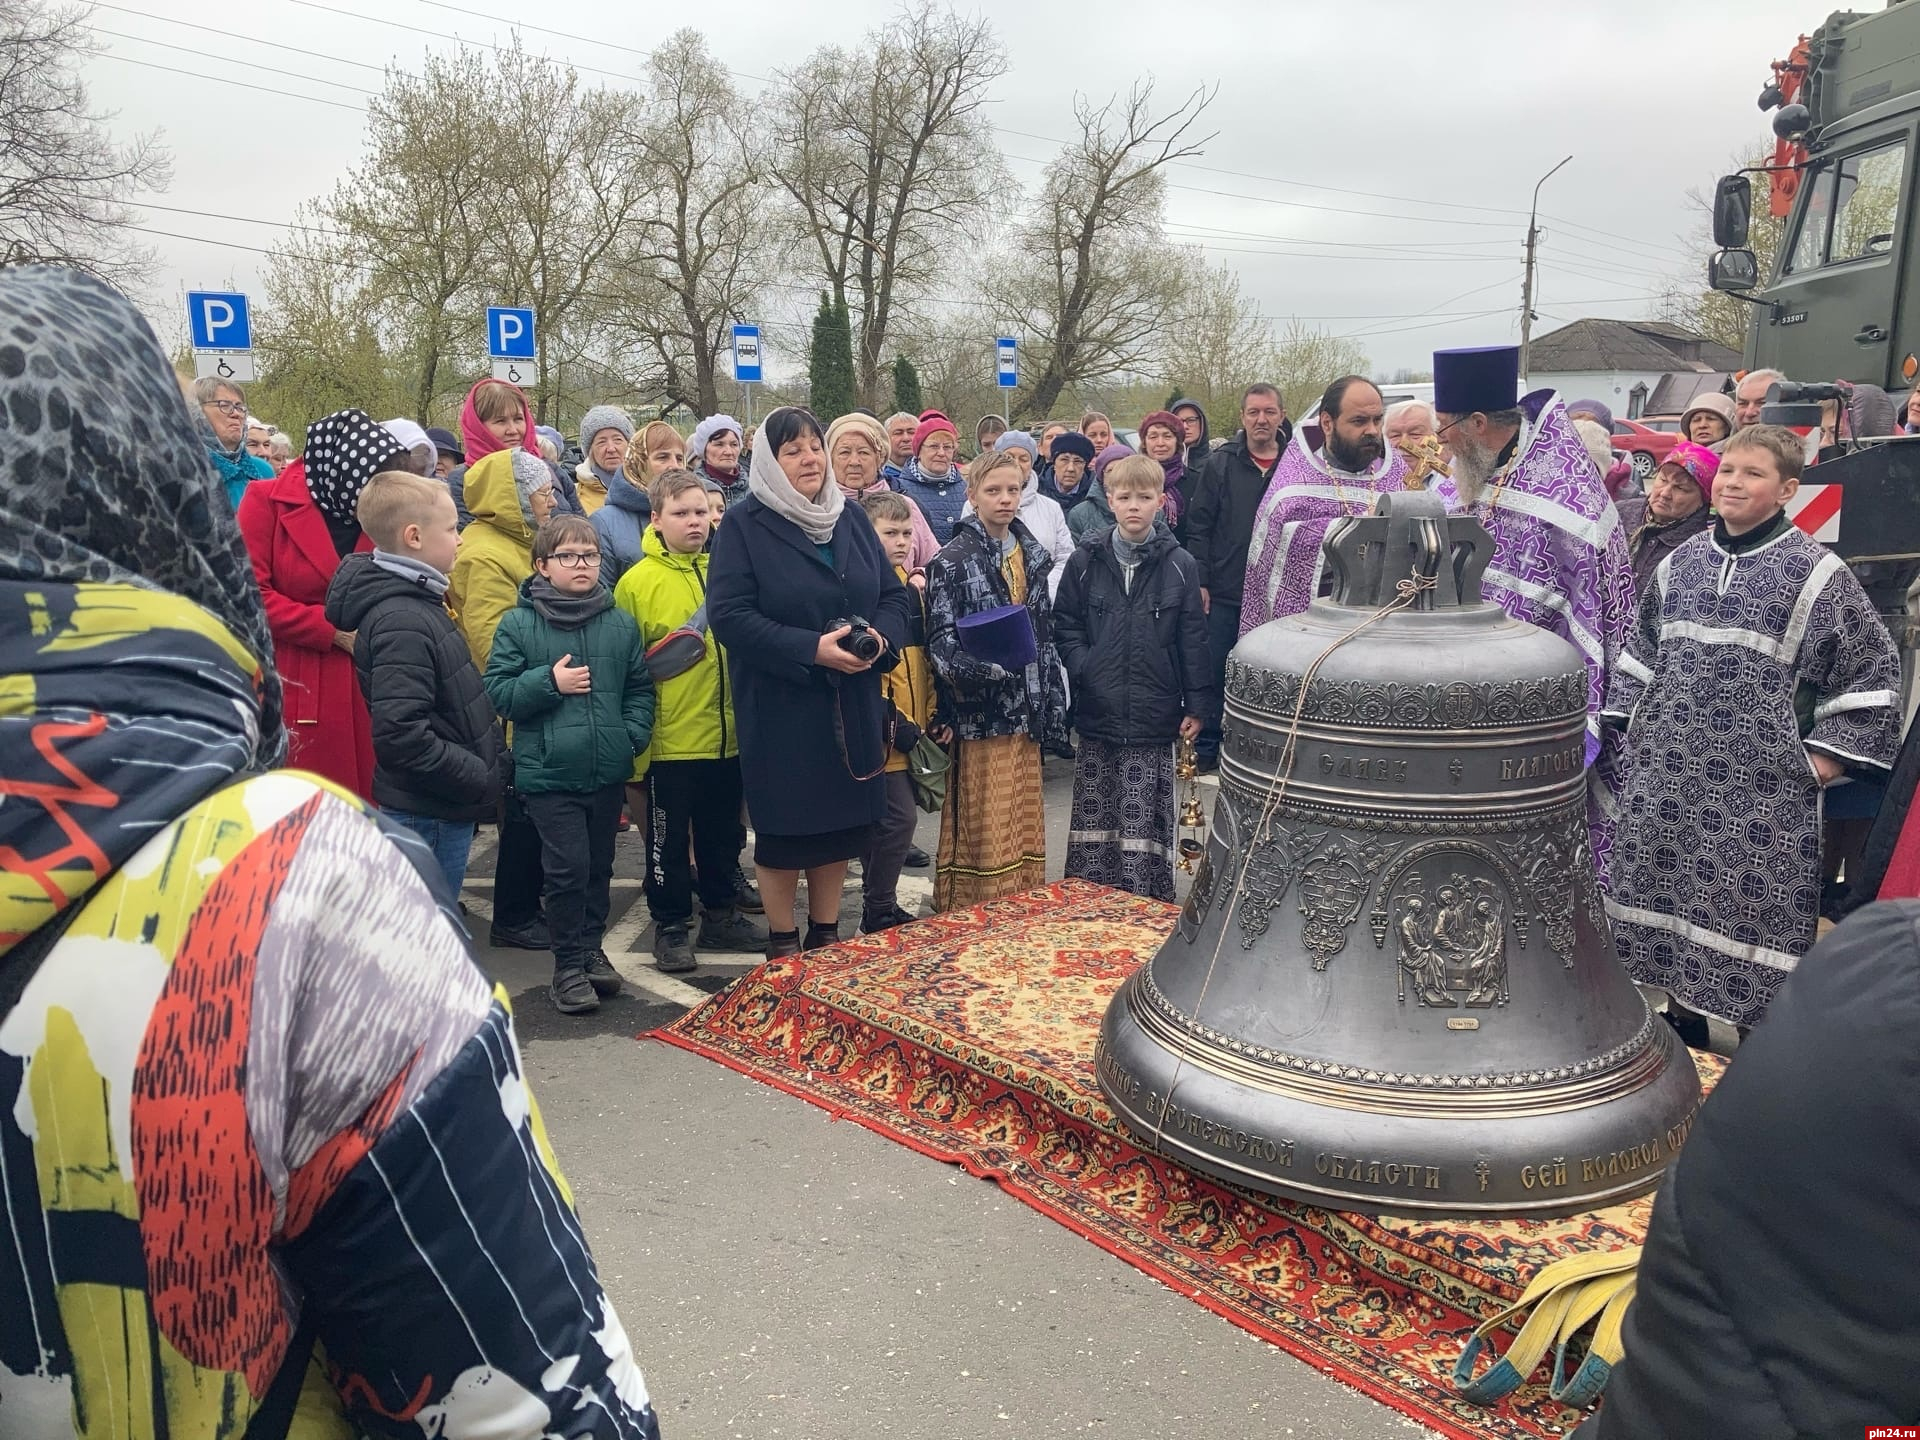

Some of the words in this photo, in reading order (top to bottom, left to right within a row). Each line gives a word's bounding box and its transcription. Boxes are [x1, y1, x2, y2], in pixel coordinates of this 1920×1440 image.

[203, 300, 234, 342] P
[500, 314, 523, 351] P
[1314, 1152, 1441, 1189] ОБЛАСТИ
[1520, 1157, 1568, 1190] СЕЙ
[1582, 1138, 1660, 1182] КОЛОКОЛ
